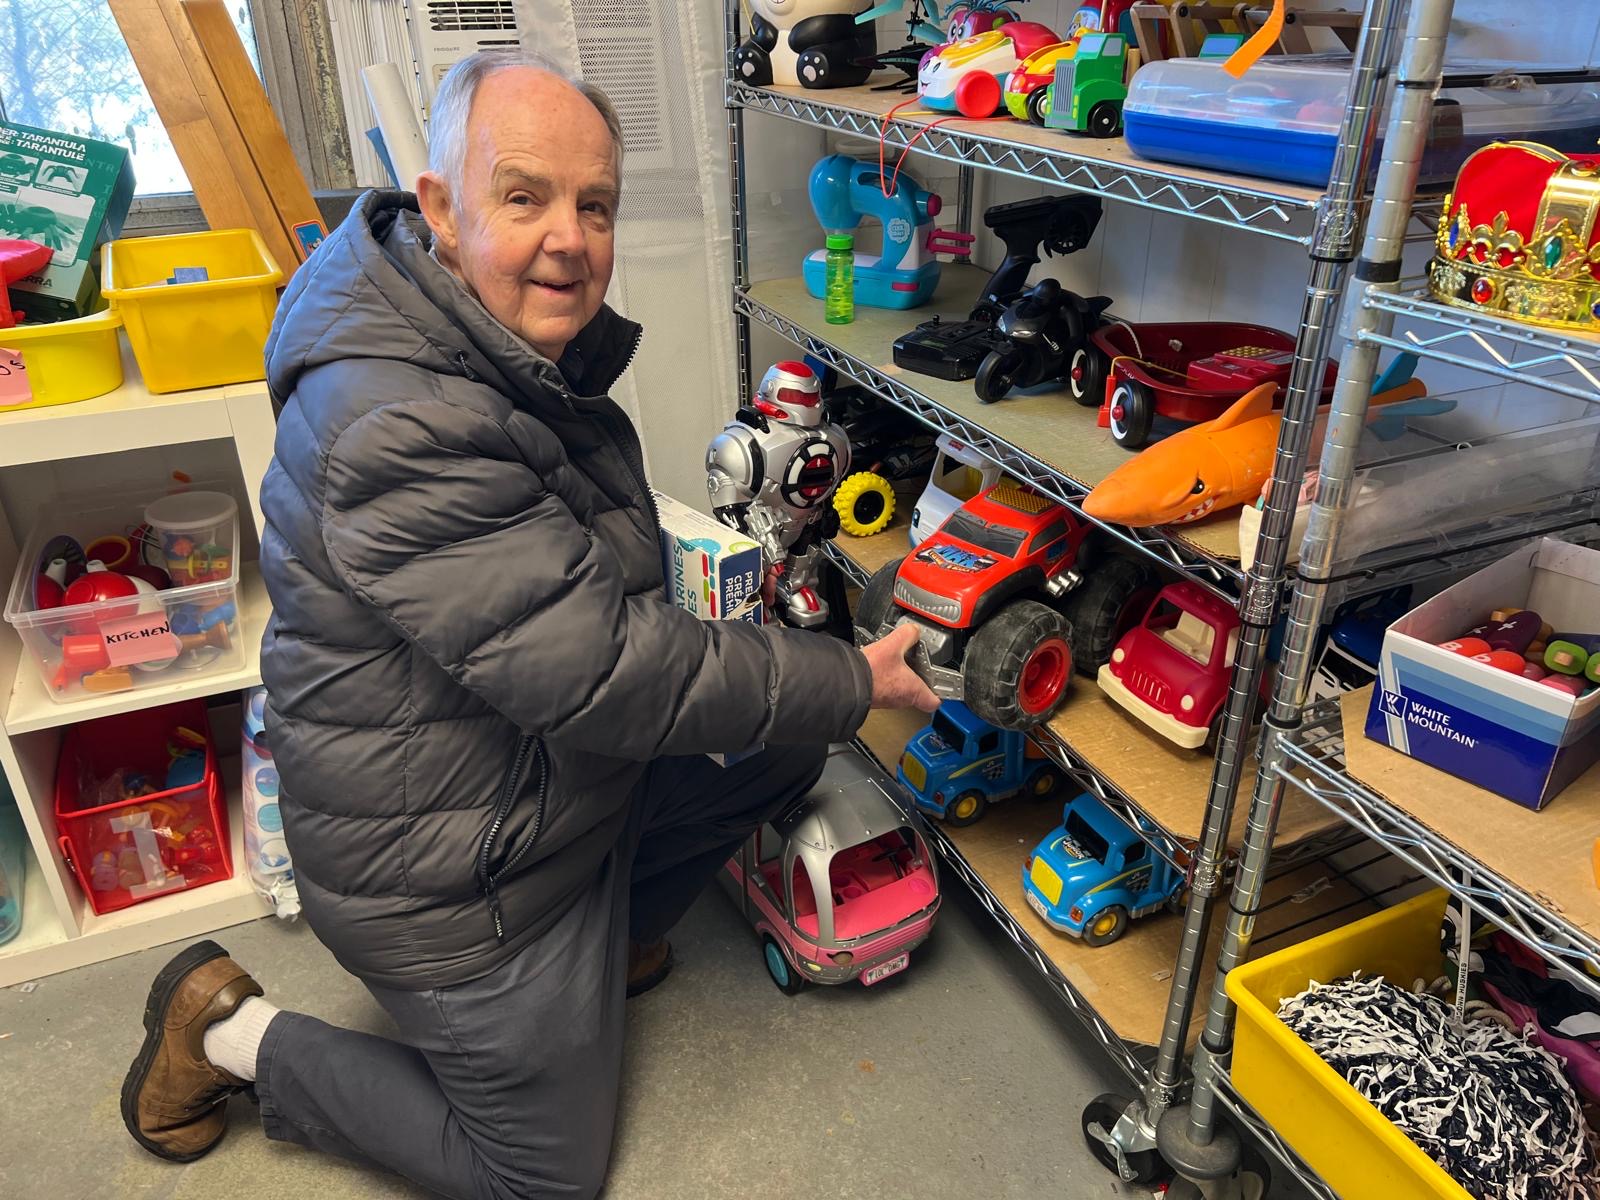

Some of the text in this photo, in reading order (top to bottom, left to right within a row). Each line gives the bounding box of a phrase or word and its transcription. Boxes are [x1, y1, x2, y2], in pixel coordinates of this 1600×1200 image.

[16, 139, 86, 161] TARANTULE
[22, 131, 86, 152] TARANTULA
[734, 574, 744, 608] CRÉA
[106, 621, 170, 644] KITCHEN
[1411, 701, 1451, 726] WHITE
[1408, 712, 1475, 749] MOUNTAIN
[1458, 962, 1467, 994] HUSKIES
